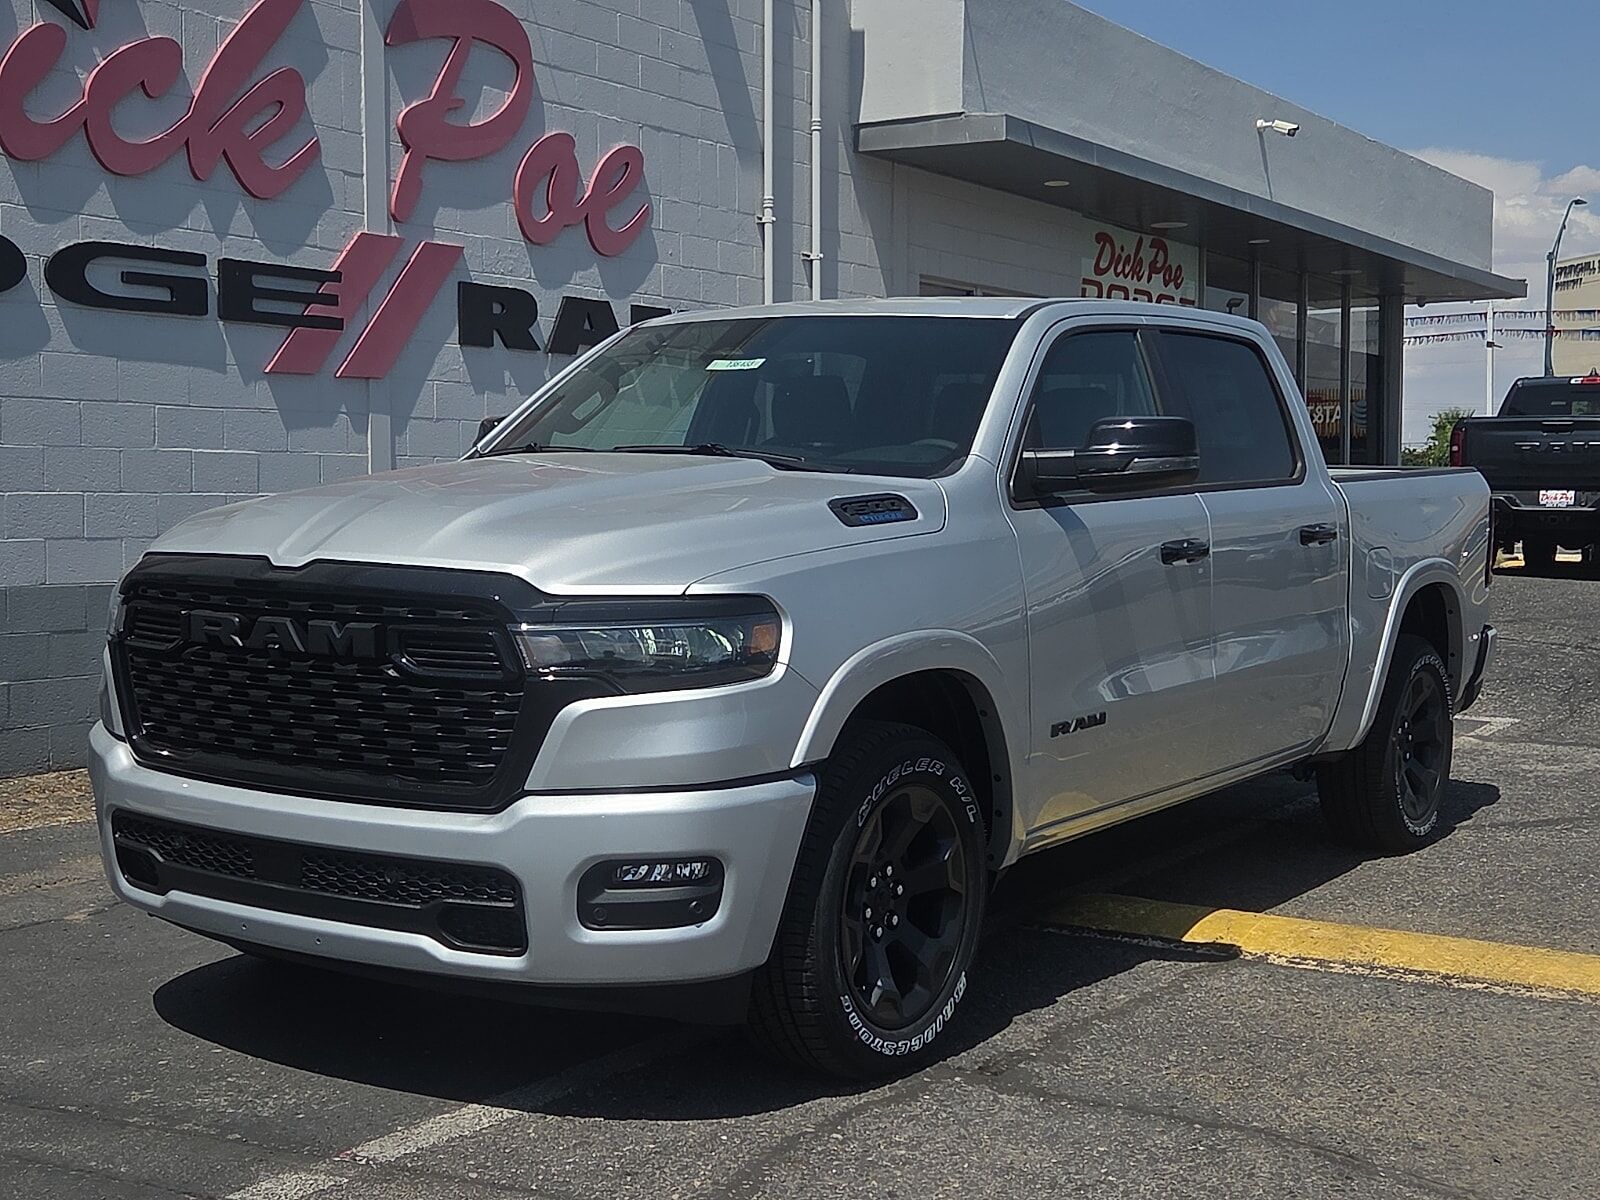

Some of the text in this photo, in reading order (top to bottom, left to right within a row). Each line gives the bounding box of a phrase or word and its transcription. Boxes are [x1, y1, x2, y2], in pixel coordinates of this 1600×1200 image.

[0, 0, 652, 257] ick Poe
[0, 233, 690, 356] GE RA
[1093, 231, 1185, 290] Dick Poe
[186, 609, 384, 659] RAM
[1049, 710, 1107, 738] RAM
[839, 970, 967, 1056] BRIDGESTONE
